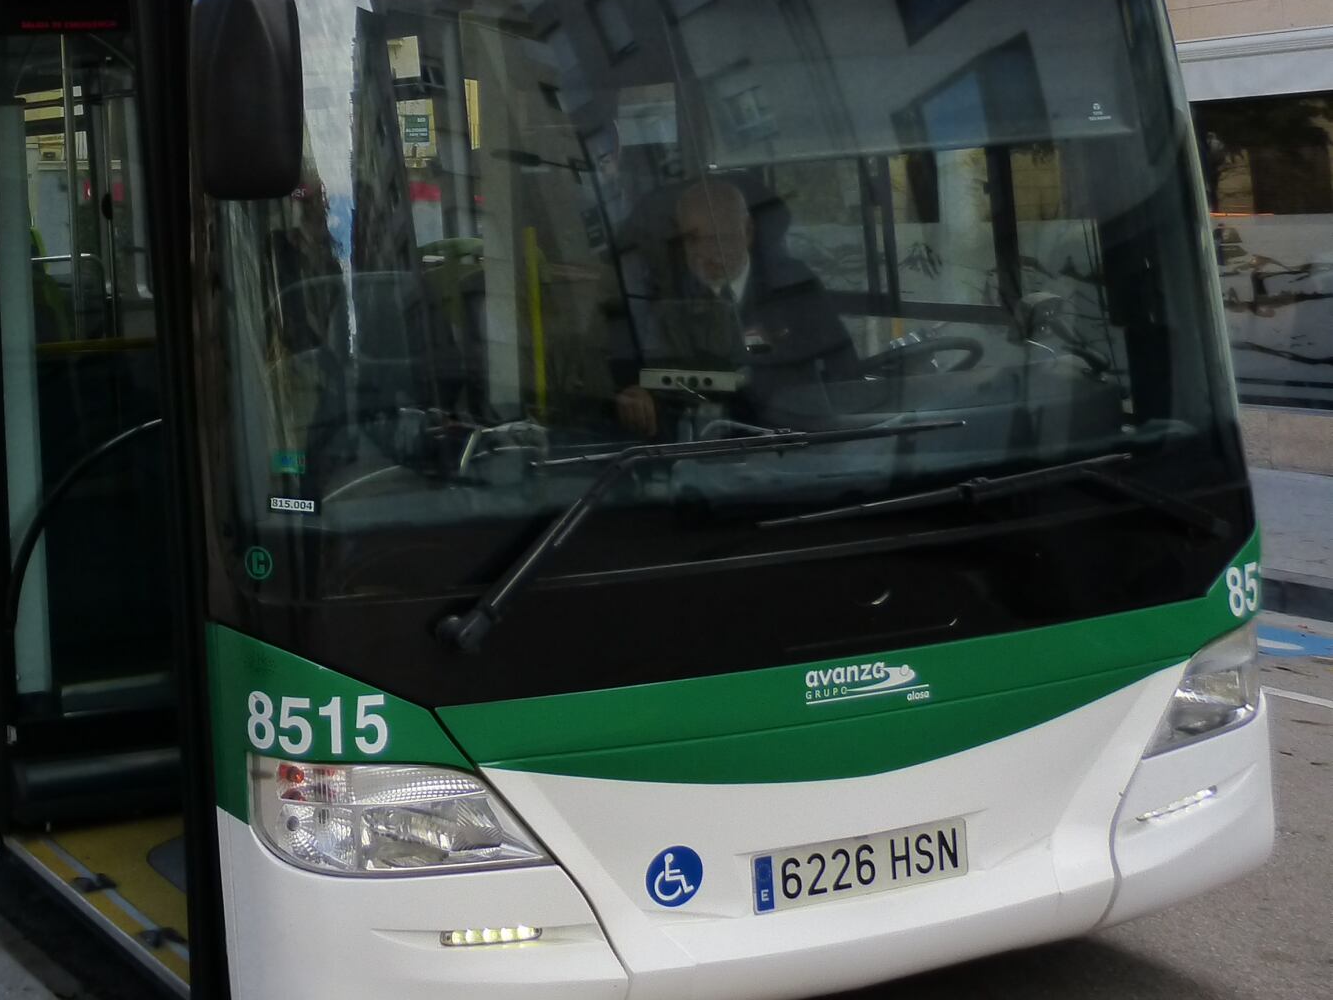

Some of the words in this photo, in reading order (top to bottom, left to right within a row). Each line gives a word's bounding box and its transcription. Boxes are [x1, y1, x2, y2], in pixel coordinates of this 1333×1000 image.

[1226, 562, 1259, 617] 85
[805, 661, 886, 688] avanza
[805, 686, 848, 700] GRUPO
[906, 689, 930, 702] alosa
[247, 690, 389, 755] 8515
[761, 889, 770, 902] E
[781, 844, 876, 900] 6226
[890, 827, 960, 881] HSN
